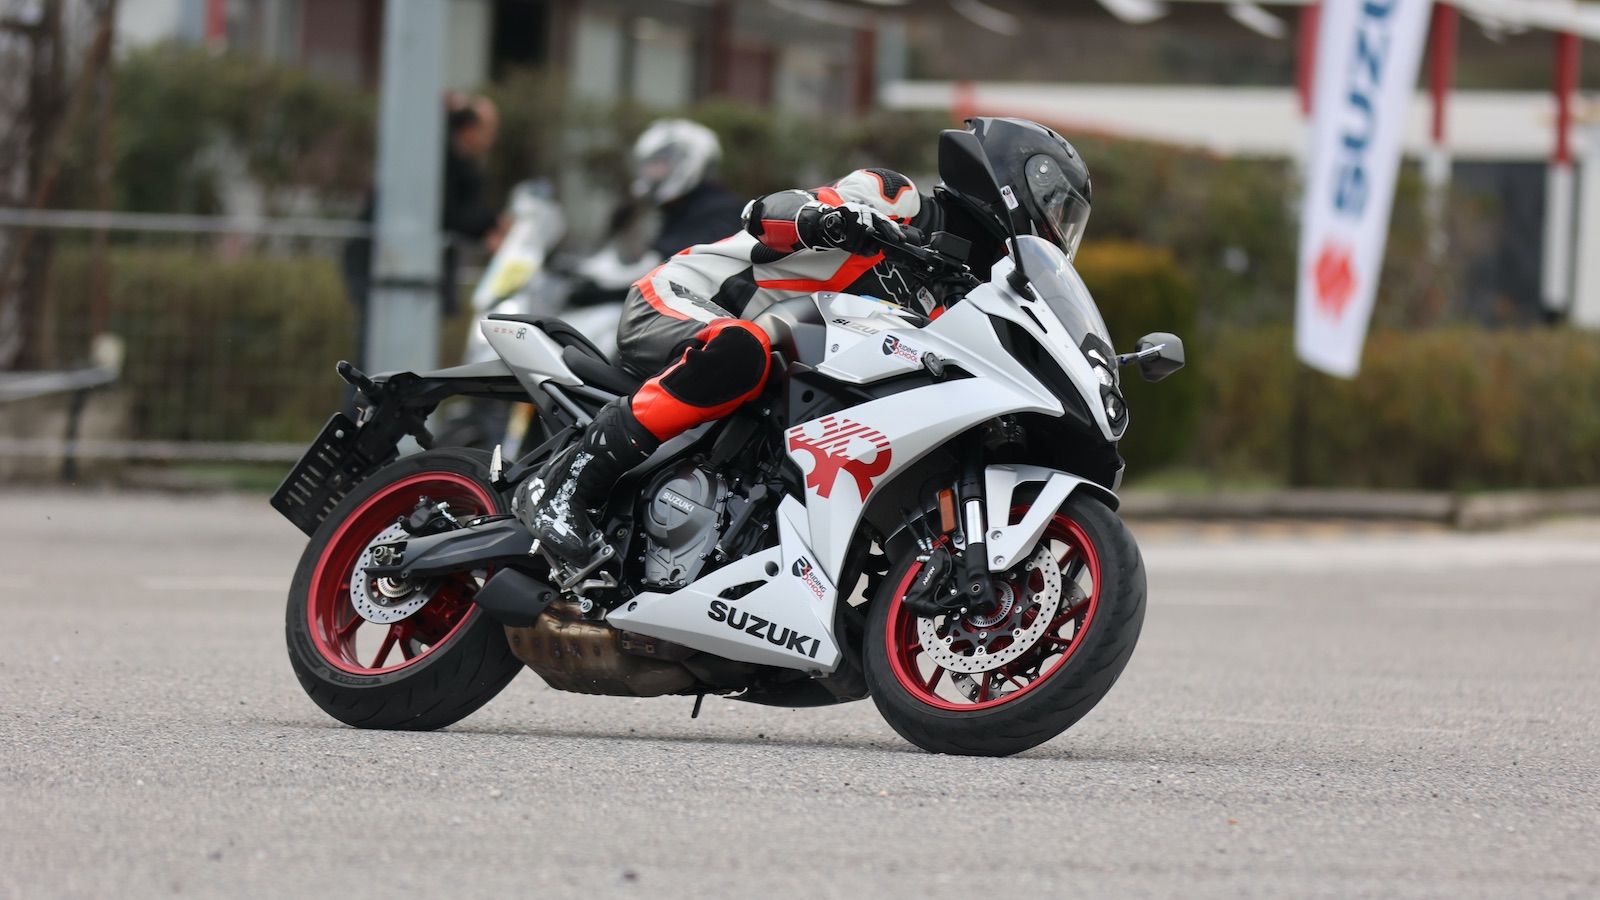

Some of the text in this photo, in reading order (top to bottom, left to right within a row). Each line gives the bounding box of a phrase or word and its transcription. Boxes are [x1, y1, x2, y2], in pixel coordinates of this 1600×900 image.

[898, 342, 918, 356] RIDING
[662, 492, 695, 512] SUZUKI
[801, 572, 824, 601] SCHOOL
[808, 571, 827, 593] RIDING
[707, 600, 821, 659] SUZUKI
